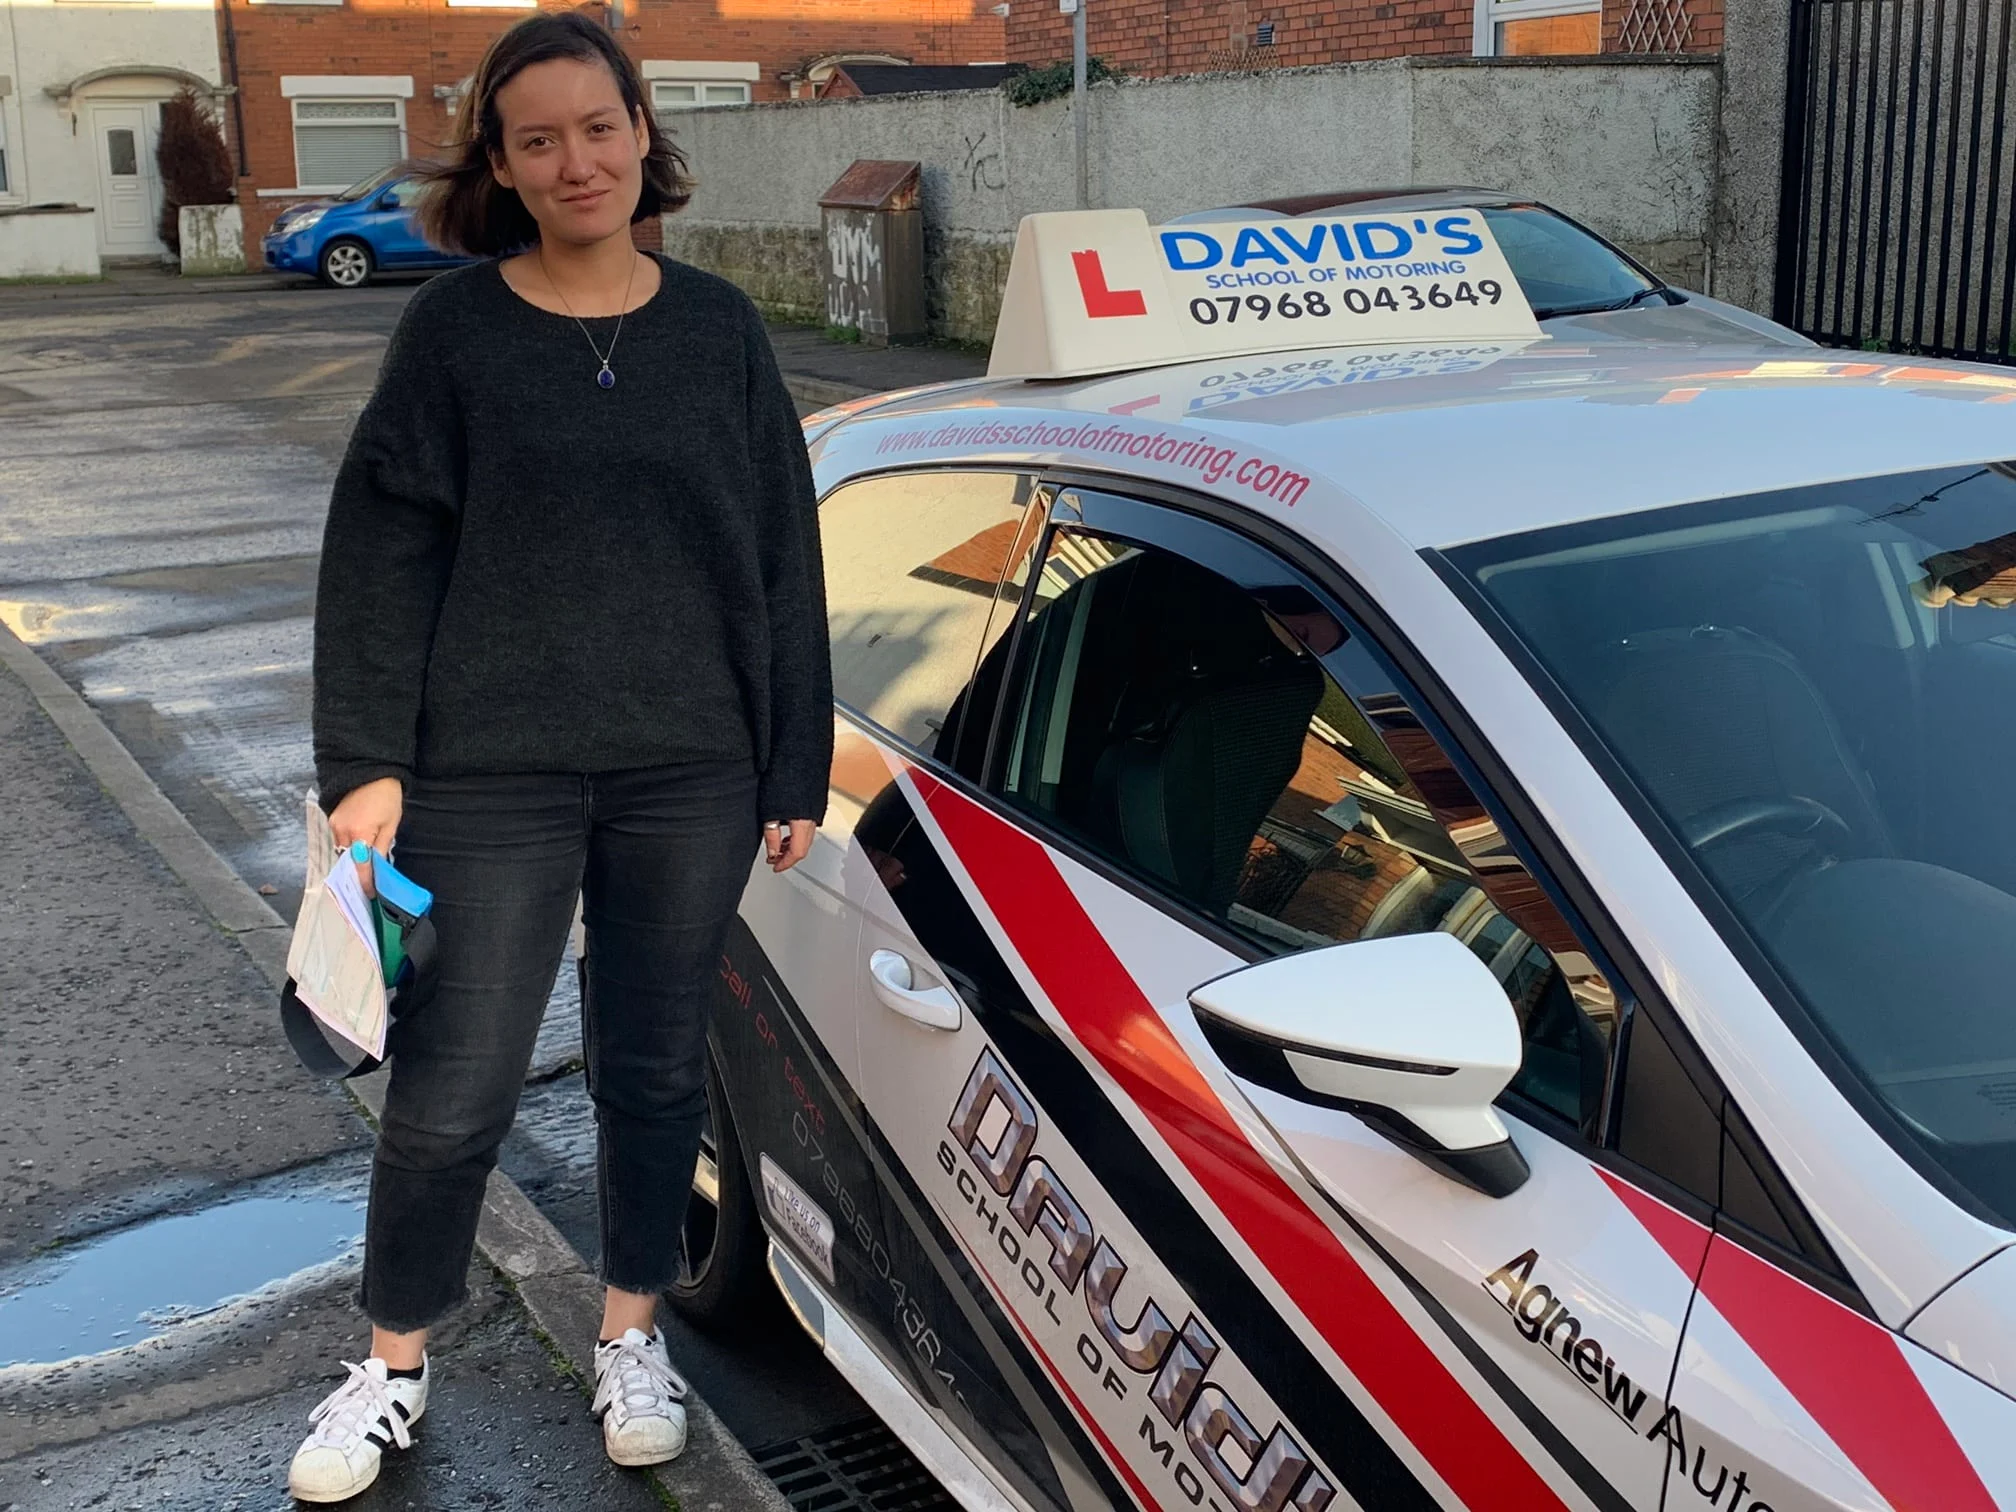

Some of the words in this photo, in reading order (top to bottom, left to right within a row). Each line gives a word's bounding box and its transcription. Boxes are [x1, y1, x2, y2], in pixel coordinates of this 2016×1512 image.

[1071, 249, 1147, 318] L
[1160, 217, 1484, 271] DAVID'S
[1205, 269, 1304, 289] SCHOOL
[1310, 267, 1339, 284] OF
[1345, 260, 1466, 281] MOTORING
[1189, 290, 1332, 325] 07968
[1344, 279, 1502, 314] 043649
[875, 419, 1311, 508] www.davidsschoolofmotoring.com
[755, 1012, 779, 1050] or
[784, 1055, 825, 1136] text
[936, 1139, 1062, 1327] SCHOOL
[1076, 1332, 1128, 1401] OF
[1137, 1414, 1222, 1512] MO
[1485, 1247, 1648, 1423] Agnew
[1646, 1405, 1776, 1512] Aut
